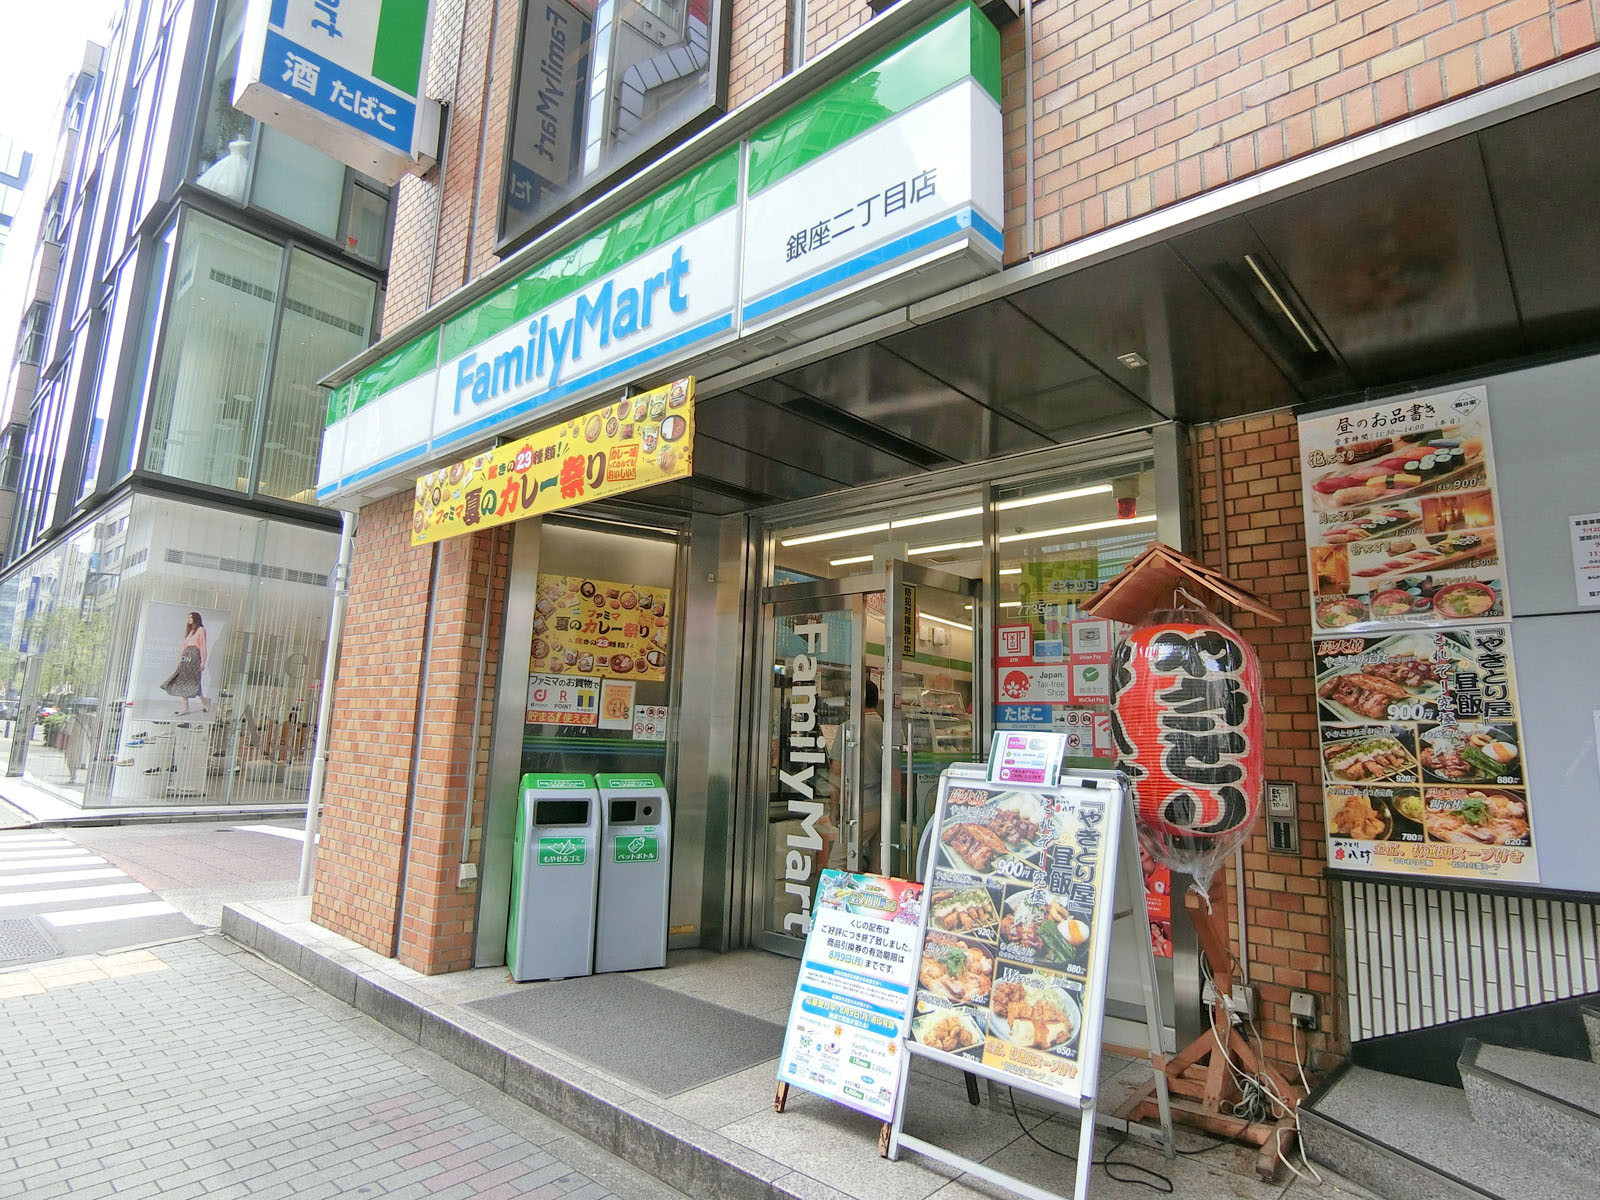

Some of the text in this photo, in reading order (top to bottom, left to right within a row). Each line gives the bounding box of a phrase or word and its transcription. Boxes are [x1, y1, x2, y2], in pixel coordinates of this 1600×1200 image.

[281, 51, 397, 132] 酒 たばこ
[785, 168, 938, 264] 銀座二丁目店
[453, 244, 691, 417] FamilyMart
[1336, 402, 1436, 436] 昼のお品書き
[1307, 450, 1355, 469] 花にぎり
[529, 675, 600, 689] ファミマのお買物で
[1037, 680, 1065, 688] Tax-free
[1047, 688, 1065, 697] Shop
[1004, 706, 1045, 721] たばこ
[779, 622, 829, 935] FamilyMart
[617, 852, 655, 860] ペットボトル
[850, 919, 890, 934] くじの配布は
[820, 924, 912, 953] ご好評につき終了致しました。
[826, 937, 905, 964] 商品引換券の有効期限は
